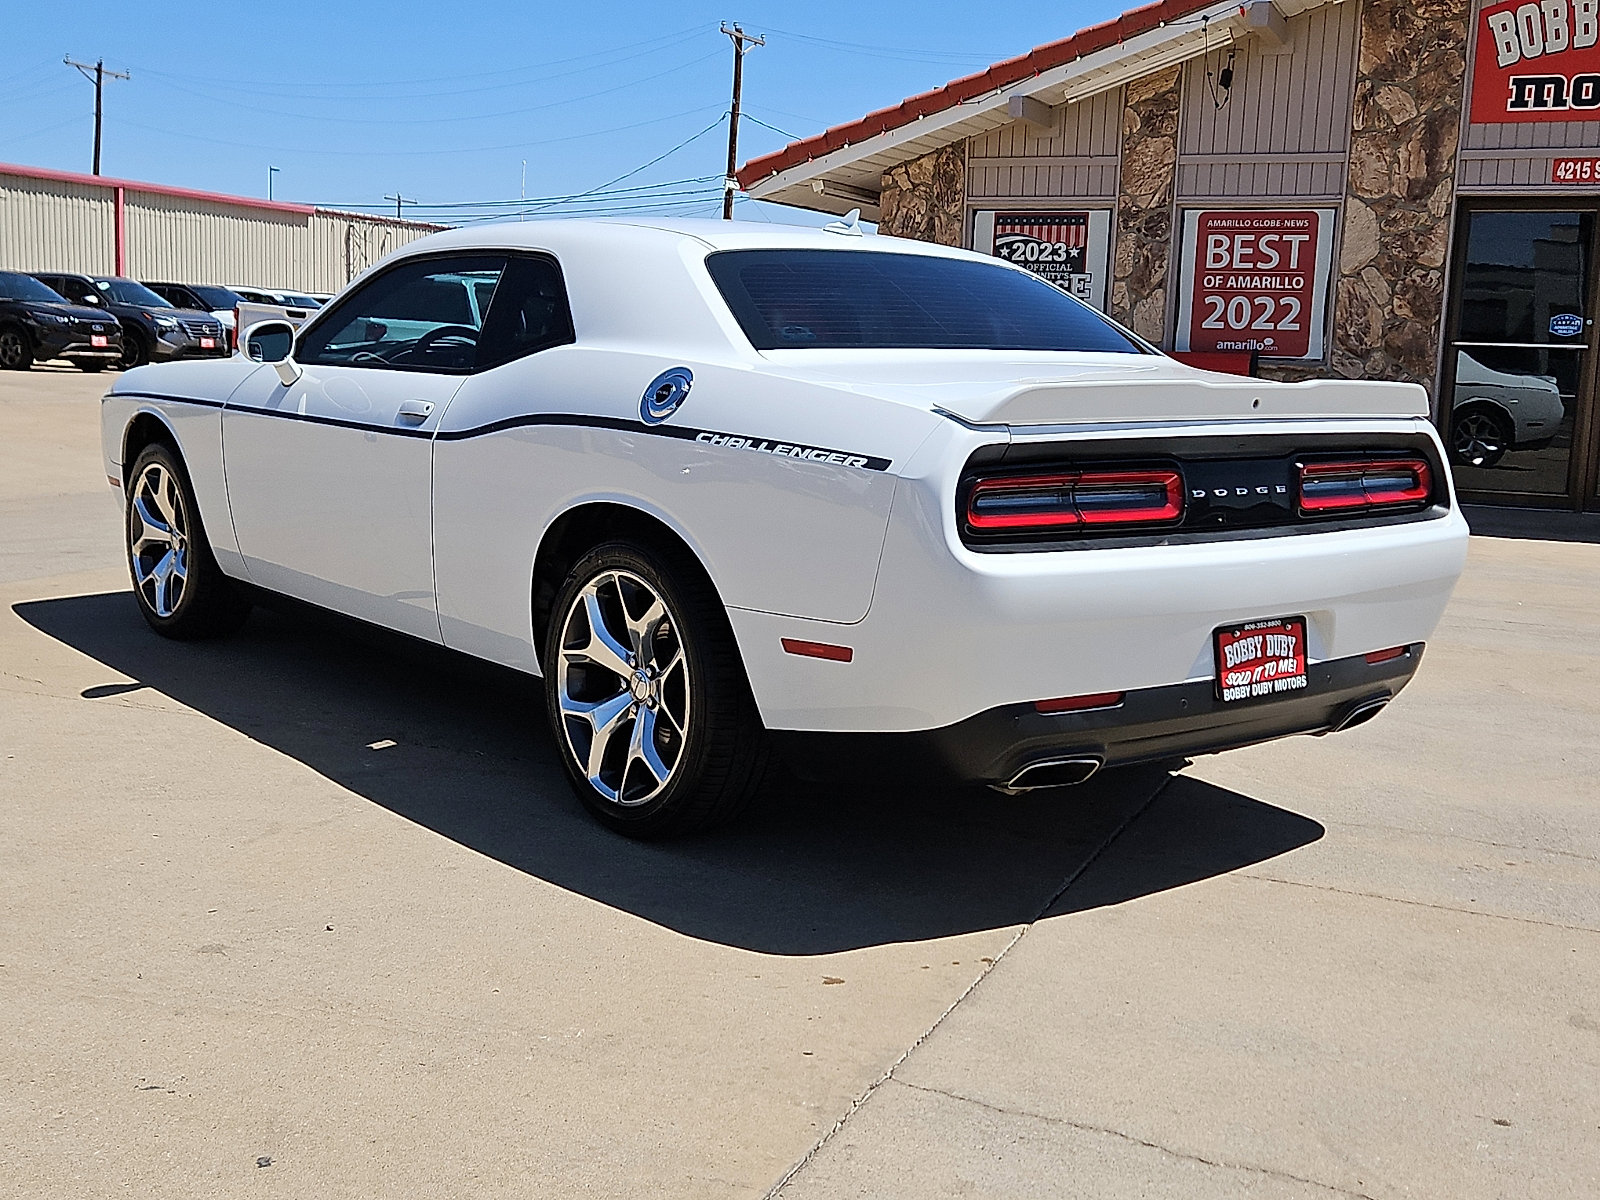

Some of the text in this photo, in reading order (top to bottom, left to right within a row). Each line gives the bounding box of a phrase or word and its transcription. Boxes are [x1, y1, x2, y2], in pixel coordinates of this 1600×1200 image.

[1557, 161, 1591, 180] 4215
[1207, 219, 1309, 227] AMARILLO GLOBE-NEWS
[1011, 242, 1067, 262] 2023
[1205, 234, 1310, 269] BEST
[1026, 263, 1073, 271] OFFICIAL
[1036, 271, 1070, 280] NITY'S
[1203, 275, 1304, 289] OF AMARILLO
[1201, 295, 1301, 331] 2022
[695, 432, 868, 469] CHALLENGER
[1192, 485, 1286, 498] DODGE
[1224, 634, 1296, 668] BOBBY DUBY
[1225, 658, 1297, 687] SOLD IT TO ME!
[1223, 675, 1307, 701] BOBBY DUBY MOTORS
